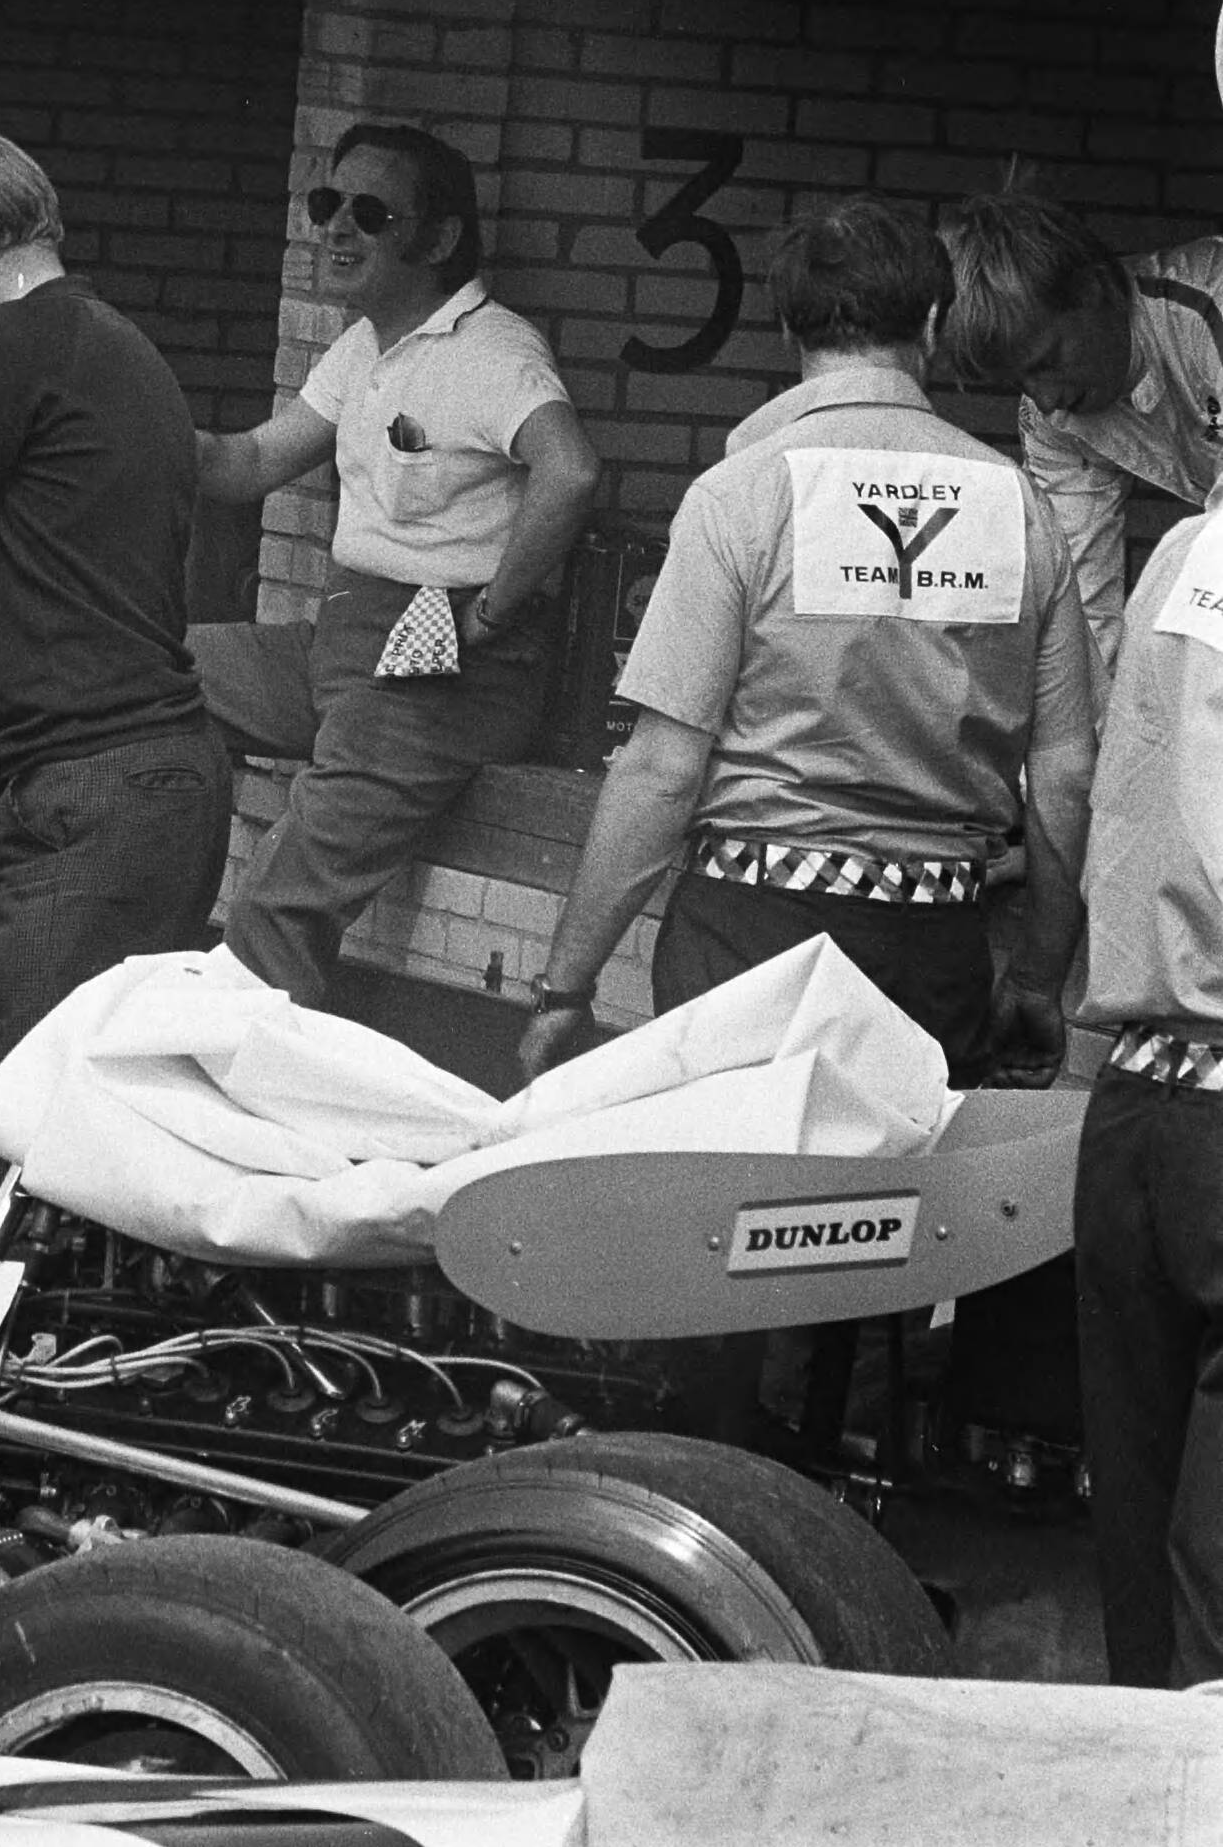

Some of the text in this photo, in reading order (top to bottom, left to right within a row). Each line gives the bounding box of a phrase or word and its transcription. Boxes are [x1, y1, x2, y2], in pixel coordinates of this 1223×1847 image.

[618, 126, 744, 373] 3
[852, 482, 962, 501] YARDLEY
[840, 566, 989, 589] TEAM B.R.M.
[745, 1217, 903, 1252] DUNLOP
